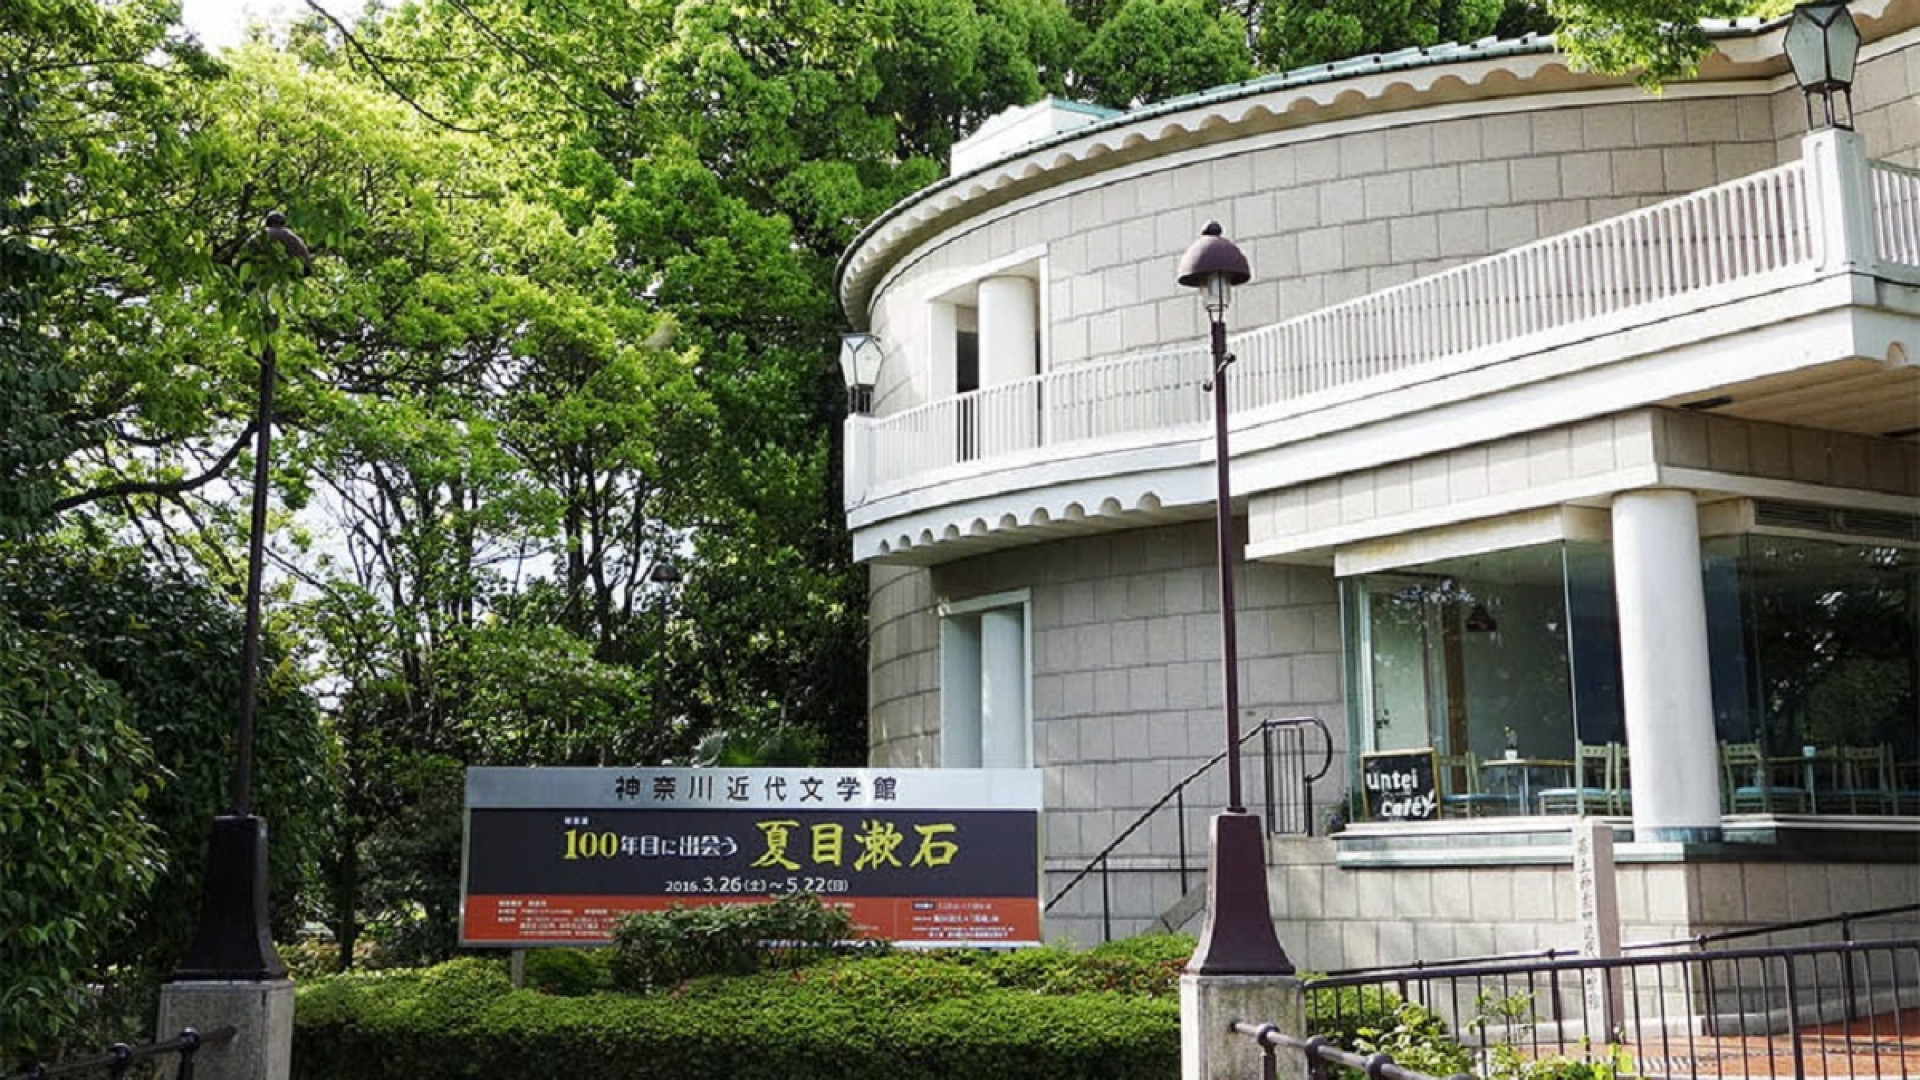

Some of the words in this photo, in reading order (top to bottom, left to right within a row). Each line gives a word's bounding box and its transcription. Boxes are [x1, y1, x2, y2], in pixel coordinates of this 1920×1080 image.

[615, 776, 897, 802] 神奈川近代文学館
[1366, 768, 1418, 791] untei
[563, 829, 738, 860] 100年目に出会う
[750, 820, 959, 871] 夏目漱石
